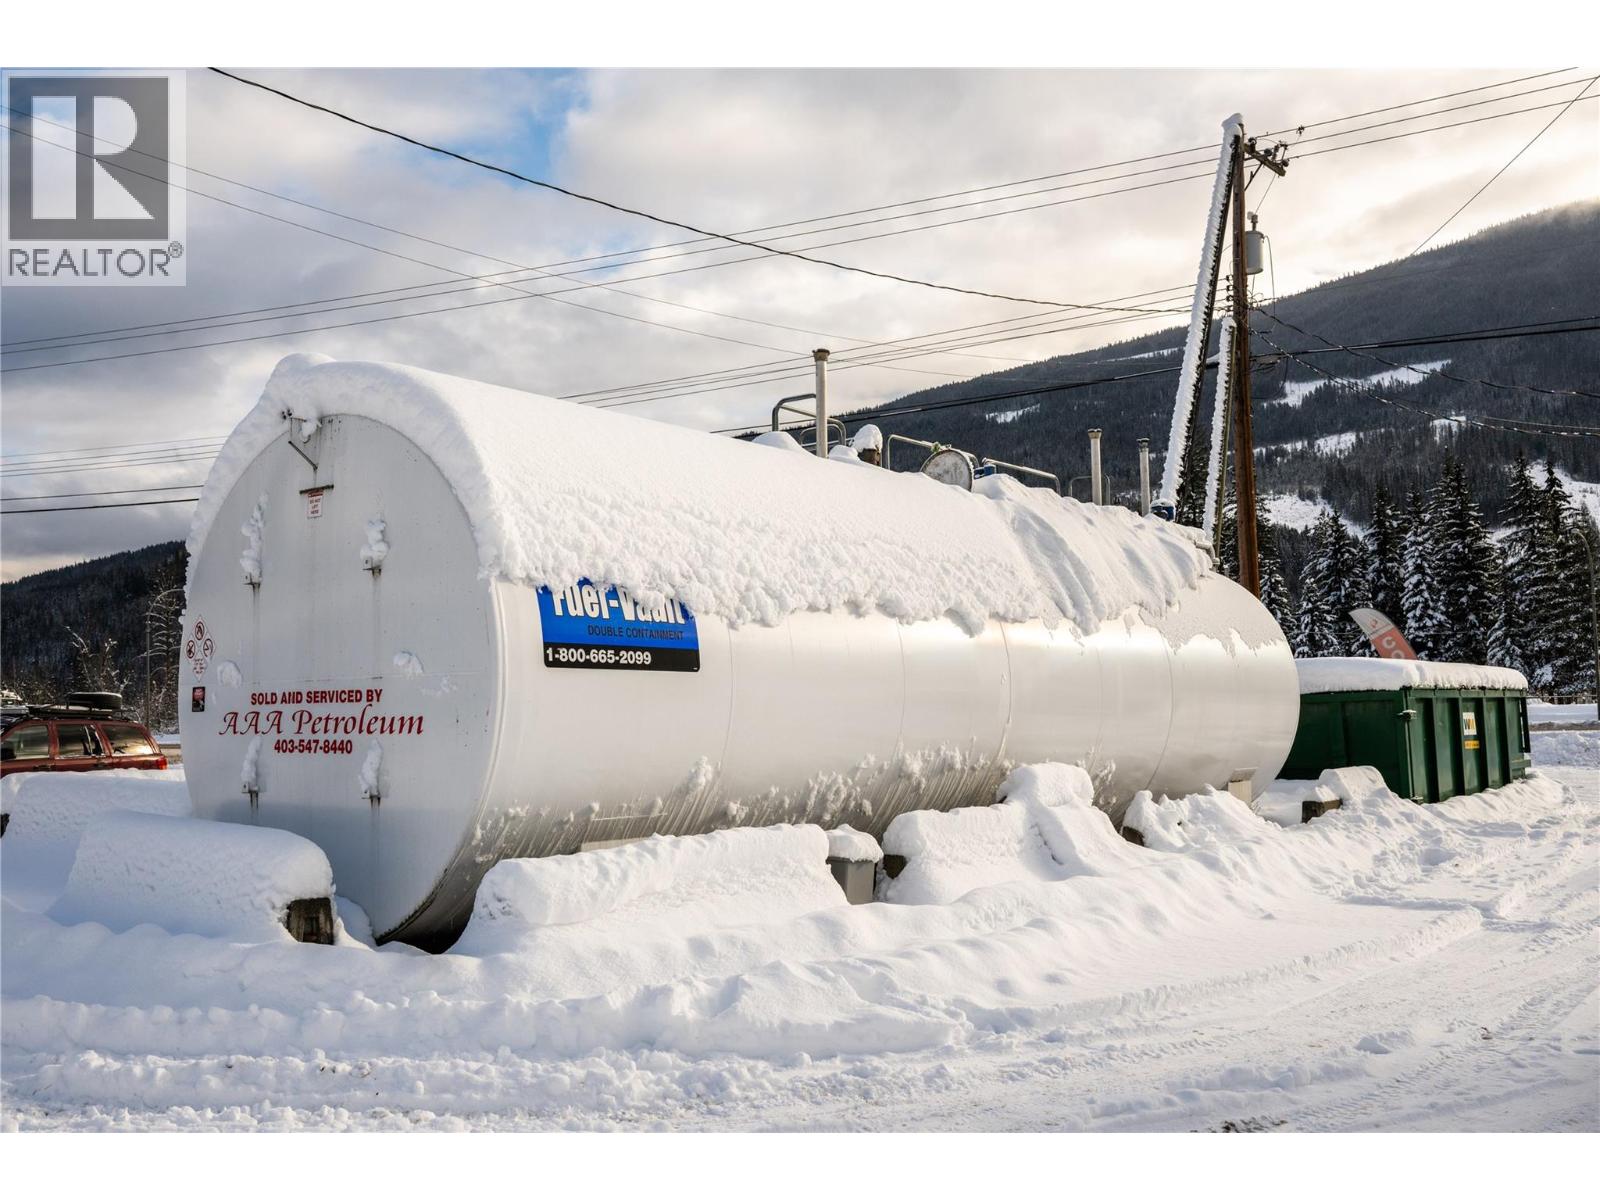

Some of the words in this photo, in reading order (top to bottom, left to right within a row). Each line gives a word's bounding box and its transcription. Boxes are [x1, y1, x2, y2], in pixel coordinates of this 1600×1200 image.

[587, 624, 623, 638] DOUBLE
[626, 626, 684, 641] CONTAINMENT
[546, 647, 652, 665] 1-800-665-2099
[250, 692, 278, 706] SOLD
[280, 691, 303, 705] AND
[305, 690, 363, 704] SERVICED
[366, 689, 383, 703] BY
[218, 710, 284, 736] AAA
[291, 703, 424, 735] Petroleum
[273, 738, 353, 755] 403-547-8440
